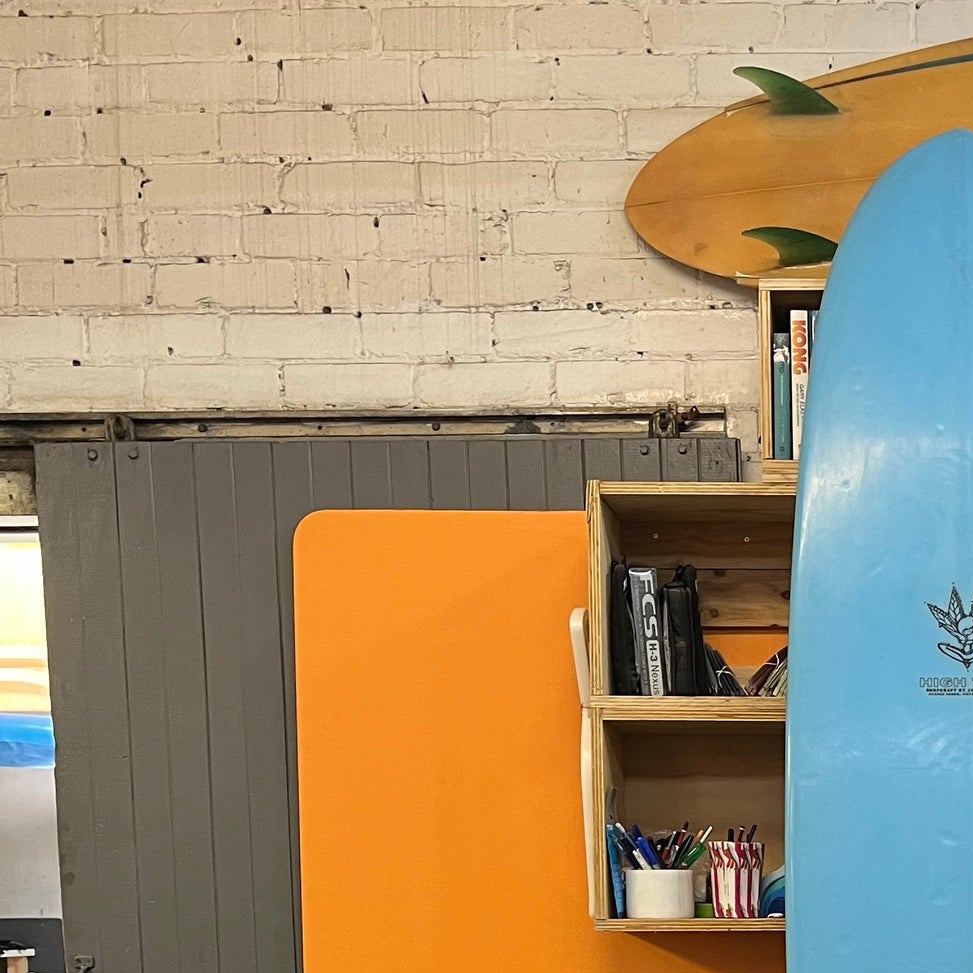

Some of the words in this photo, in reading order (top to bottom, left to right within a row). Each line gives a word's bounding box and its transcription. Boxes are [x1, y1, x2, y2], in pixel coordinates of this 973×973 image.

[792, 320, 807, 375] KONG
[640, 573, 658, 639] FCS
[651, 664, 662, 696] Nexus
[920, 677, 966, 687] HIGH
